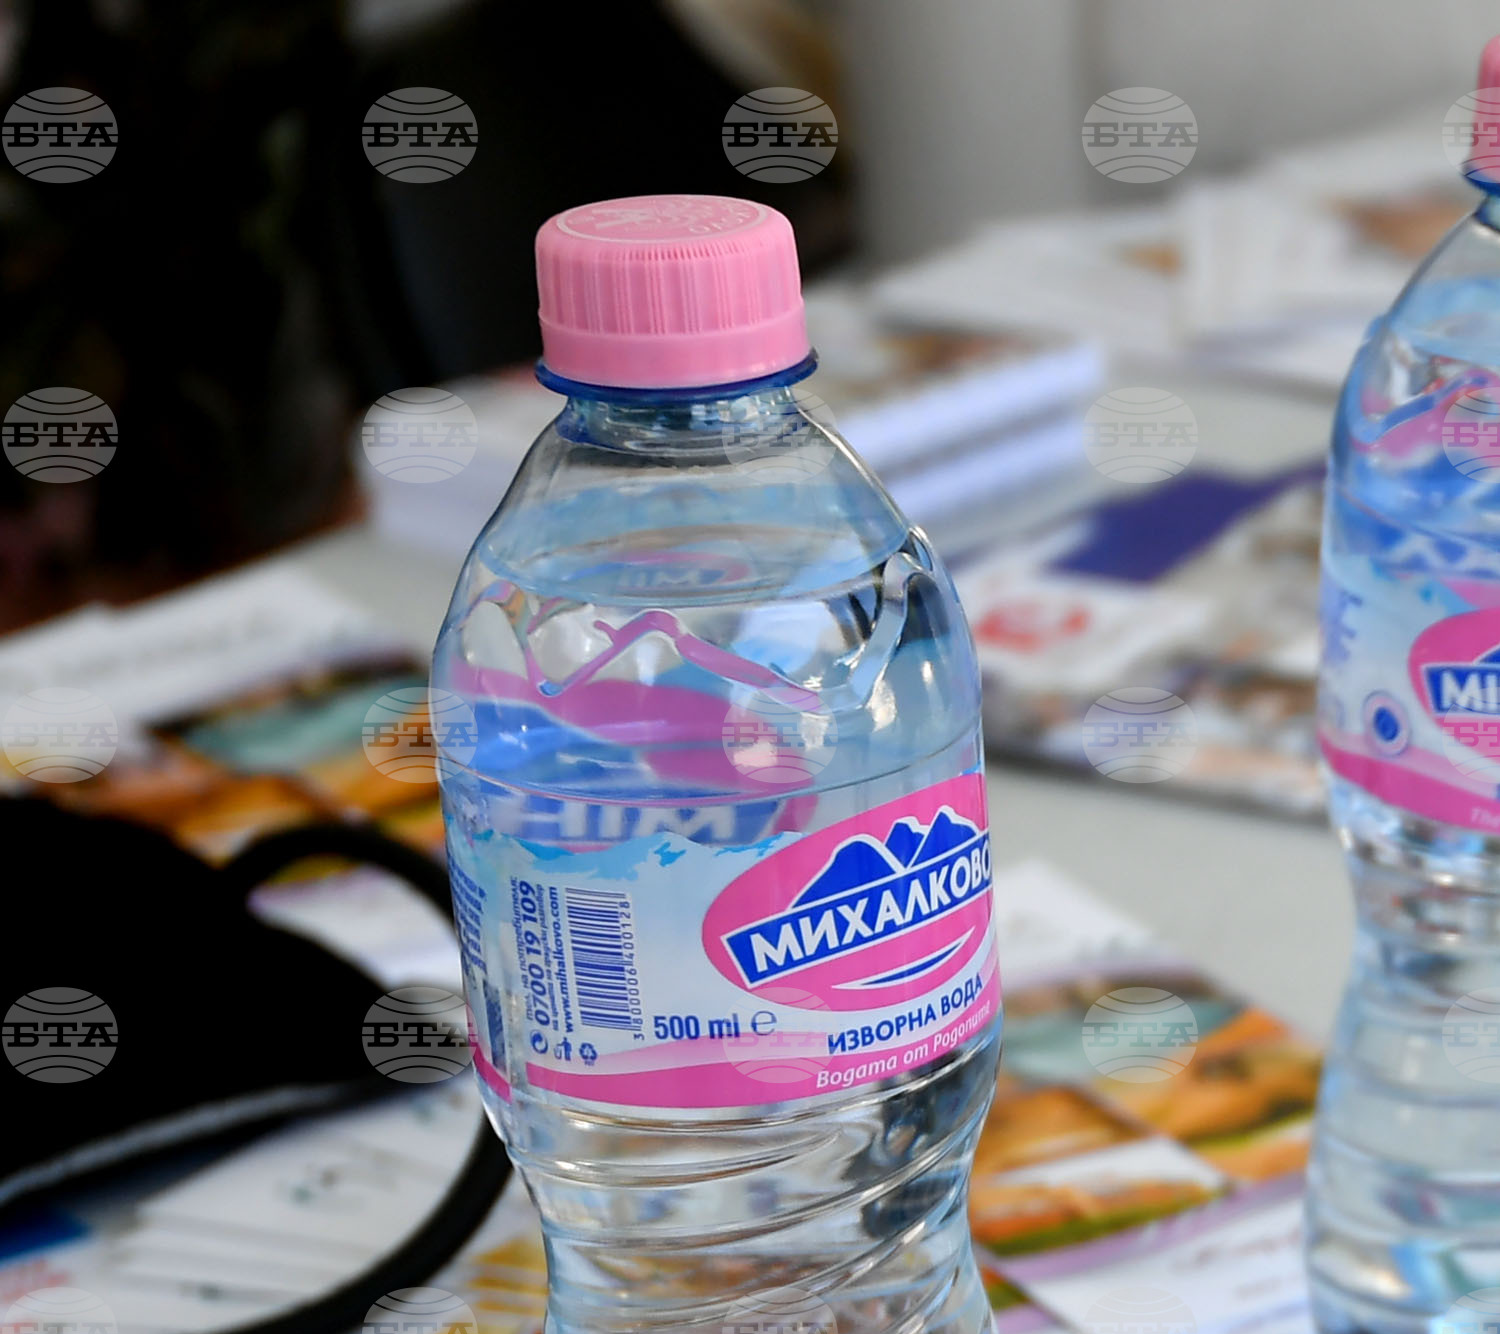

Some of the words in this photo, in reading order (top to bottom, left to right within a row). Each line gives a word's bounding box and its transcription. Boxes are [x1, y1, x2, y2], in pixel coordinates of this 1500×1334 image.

[519, 881, 538, 923] 109
[524, 931, 542, 956] 19
[548, 886, 574, 1033] www.mihalkovo.com
[528, 963, 550, 1026] 0700
[827, 1011, 937, 1055] ИЗВОРНА
[941, 974, 984, 1016] ВОДА
[654, 1015, 700, 1039] 500
[708, 1013, 739, 1039] ml
